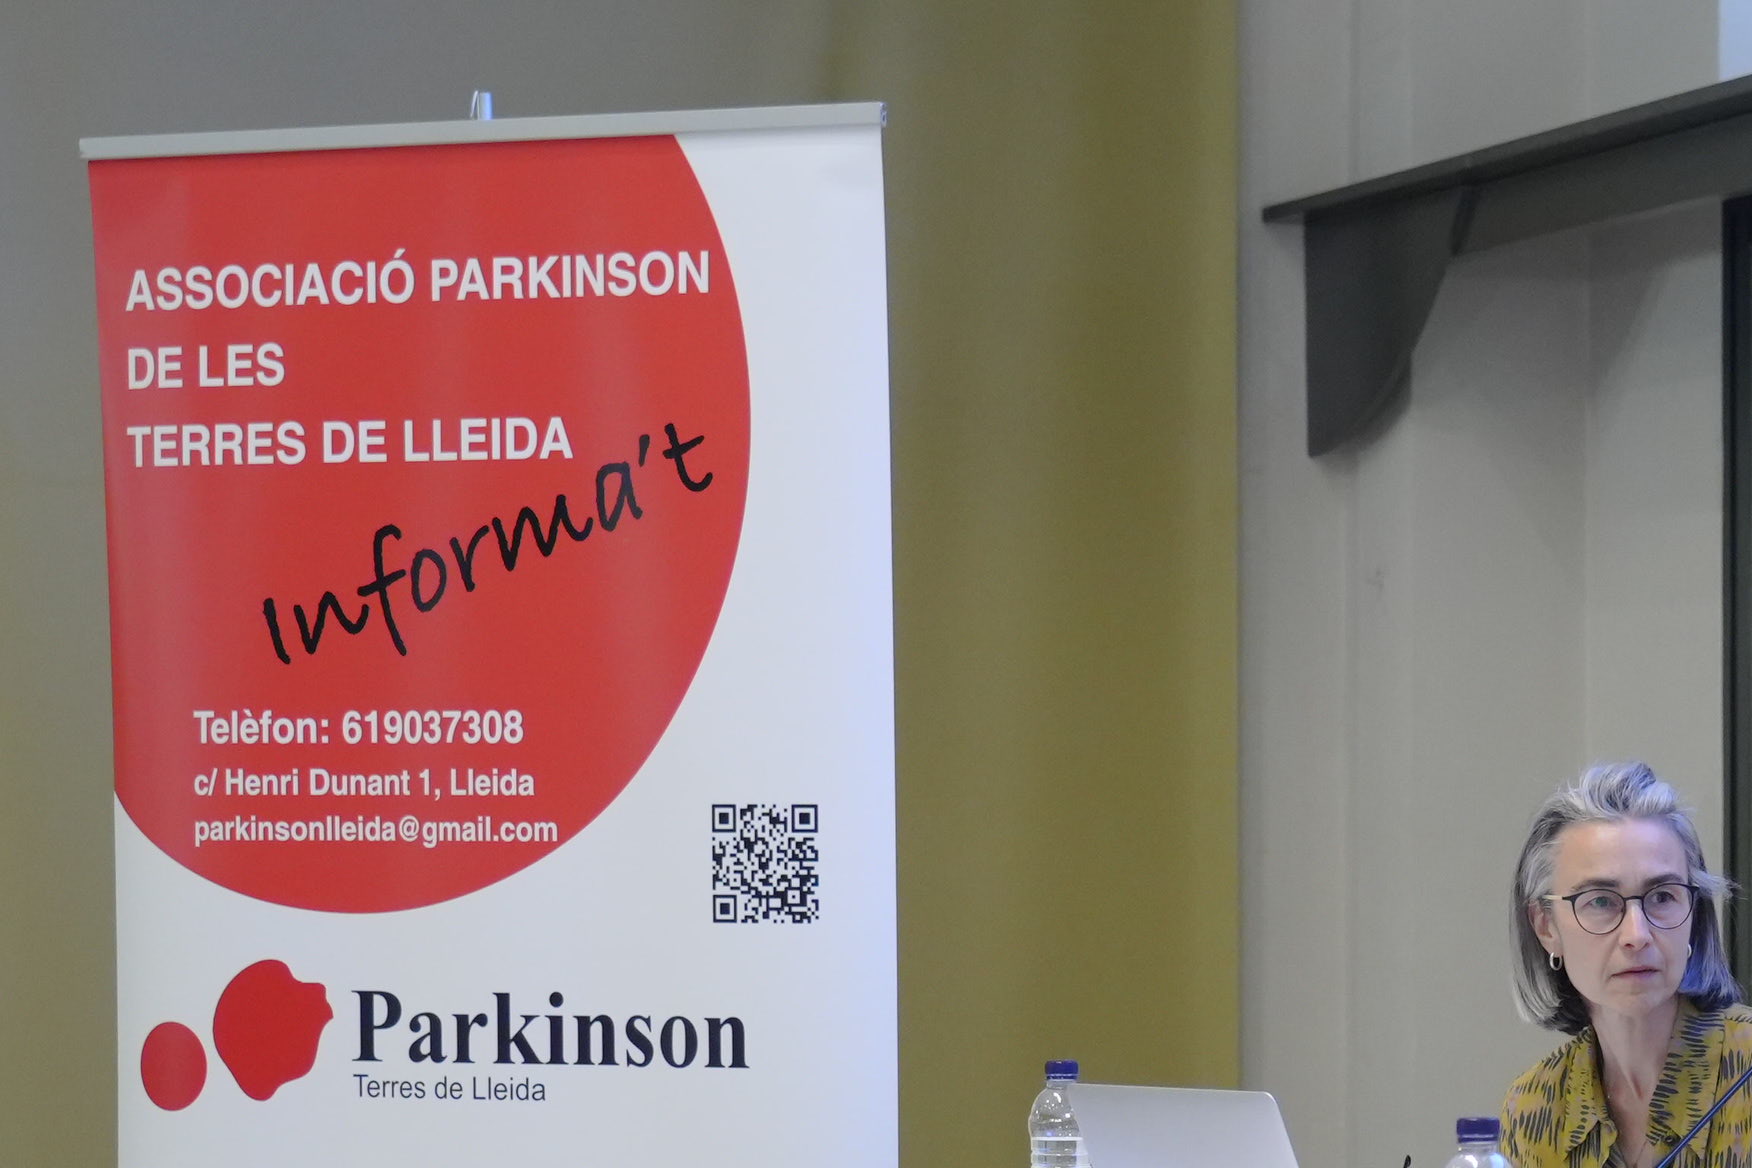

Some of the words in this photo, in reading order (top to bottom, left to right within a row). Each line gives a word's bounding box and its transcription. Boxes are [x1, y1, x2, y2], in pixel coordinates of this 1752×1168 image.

[125, 247, 415, 312] ASSOCIACIÓ
[431, 250, 709, 302] PARKINSON
[127, 346, 184, 390] DE
[198, 342, 285, 387] LES
[126, 420, 306, 468] TERRES
[322, 420, 388, 464] DE
[403, 416, 574, 462] LLEIDA
[262, 422, 714, 665] Informa't
[192, 708, 329, 745] Telèfon:
[342, 709, 524, 745] 619037308
[193, 767, 218, 797] c/
[225, 768, 299, 796] Henri
[309, 768, 411, 796] Dunant
[419, 768, 441, 801] 1,
[450, 767, 535, 797] Lleida
[194, 814, 558, 849] parkinsonlleida@gmail.com
[351, 990, 749, 1069] Parkinson
[353, 1073, 426, 1099] Terres
[434, 1076, 463, 1100] de
[472, 1076, 546, 1101] Lleida
